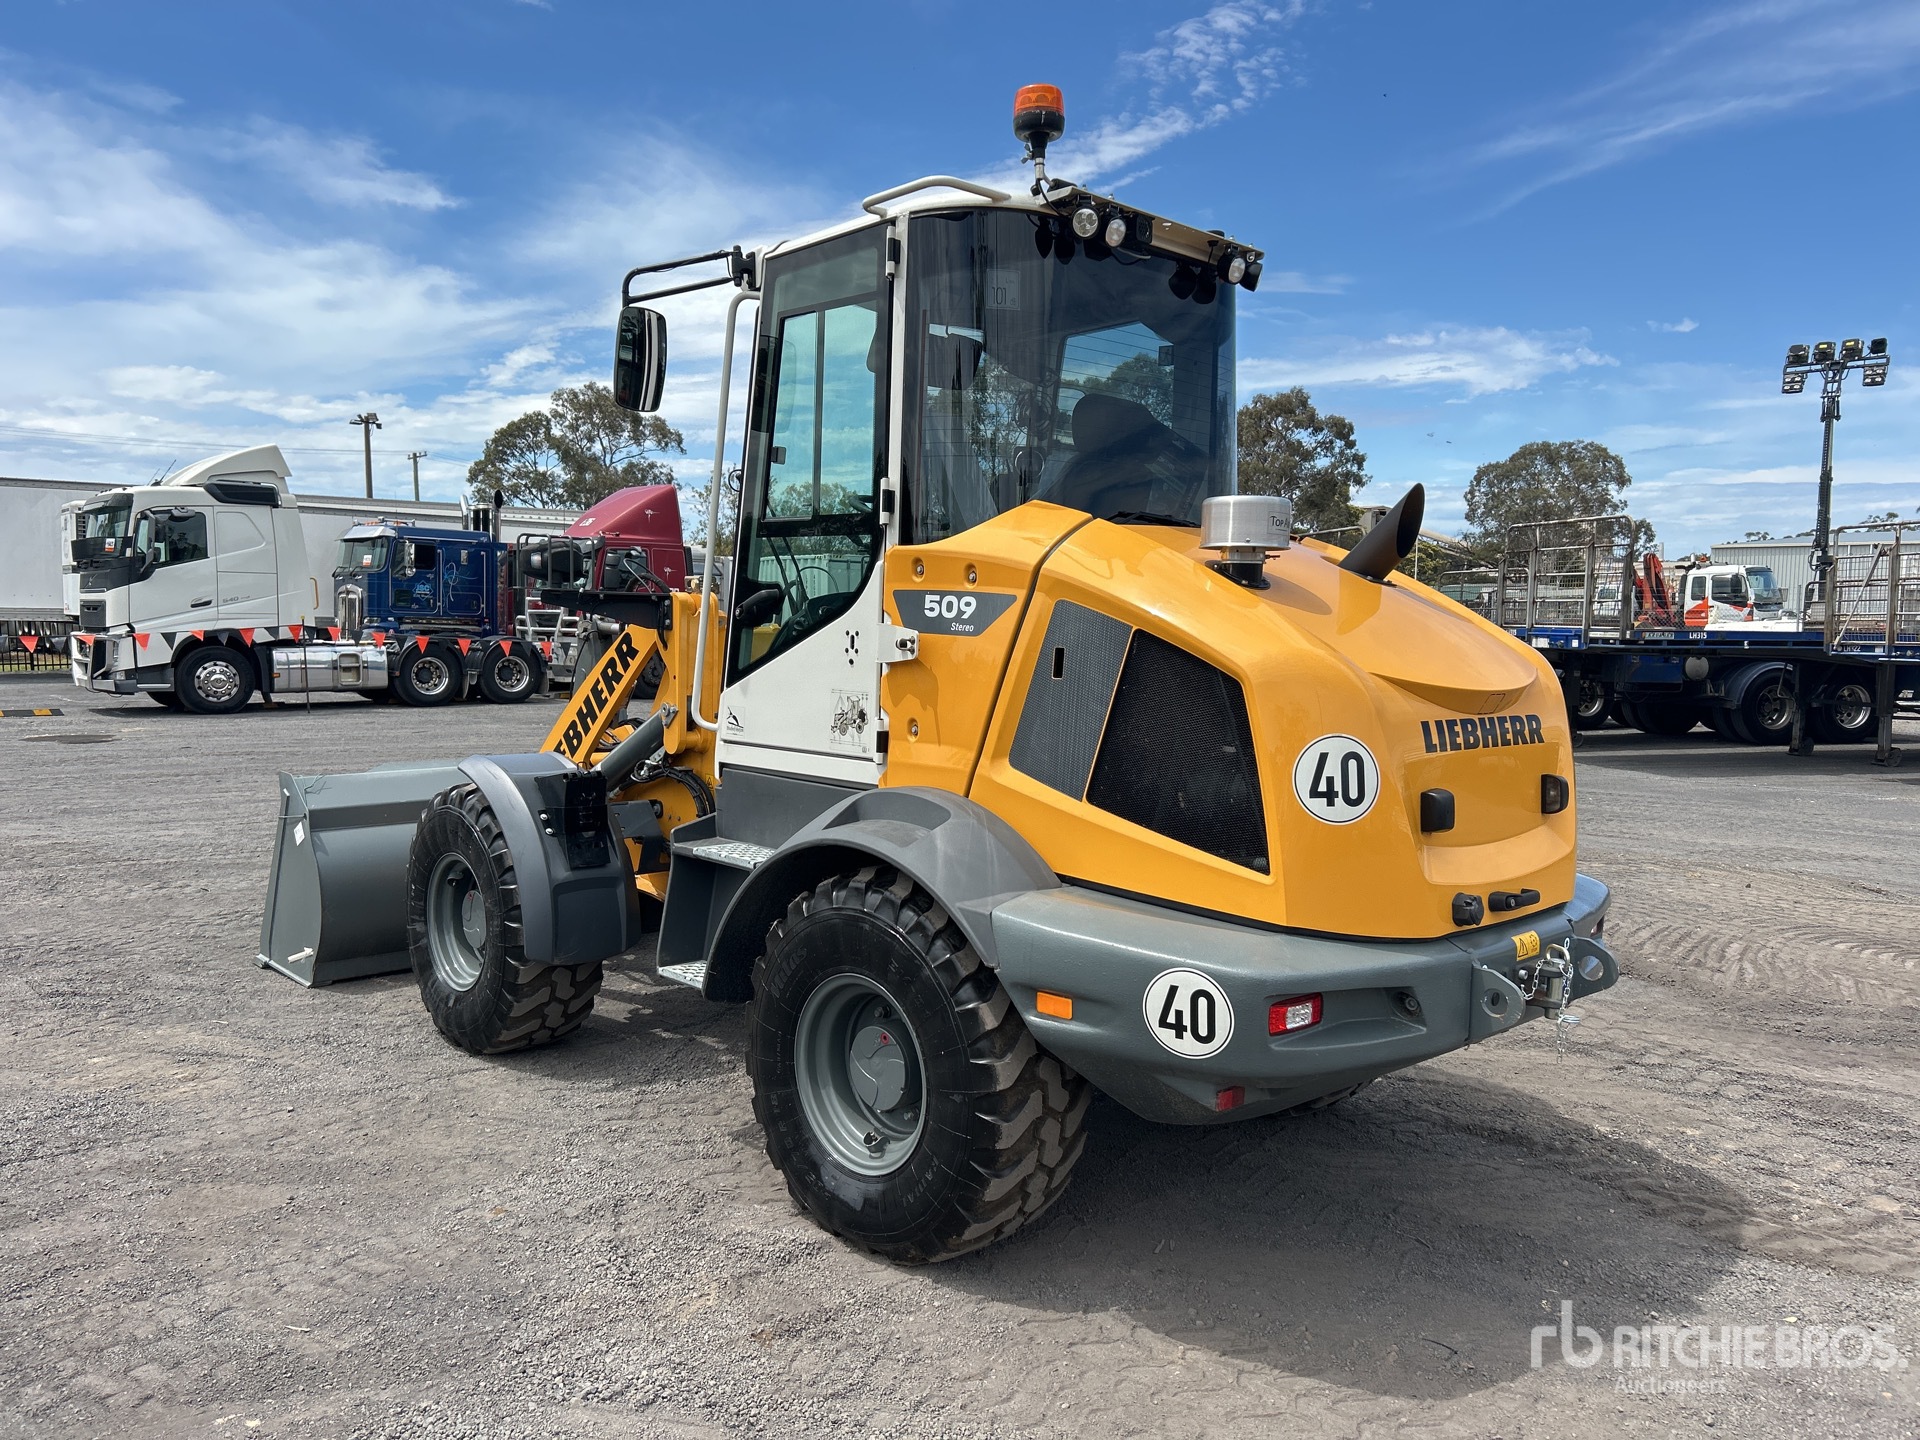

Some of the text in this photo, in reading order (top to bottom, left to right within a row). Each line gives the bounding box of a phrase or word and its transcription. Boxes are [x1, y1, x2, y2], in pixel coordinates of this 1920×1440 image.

[991, 286, 1007, 305] 101
[923, 594, 977, 619] 509
[950, 621, 975, 633] Stereo
[1689, 631, 1708, 640] LH315
[1420, 714, 1545, 754] LIEBHERR
[1308, 750, 1366, 808] 40
[1158, 984, 1216, 1045] 40
